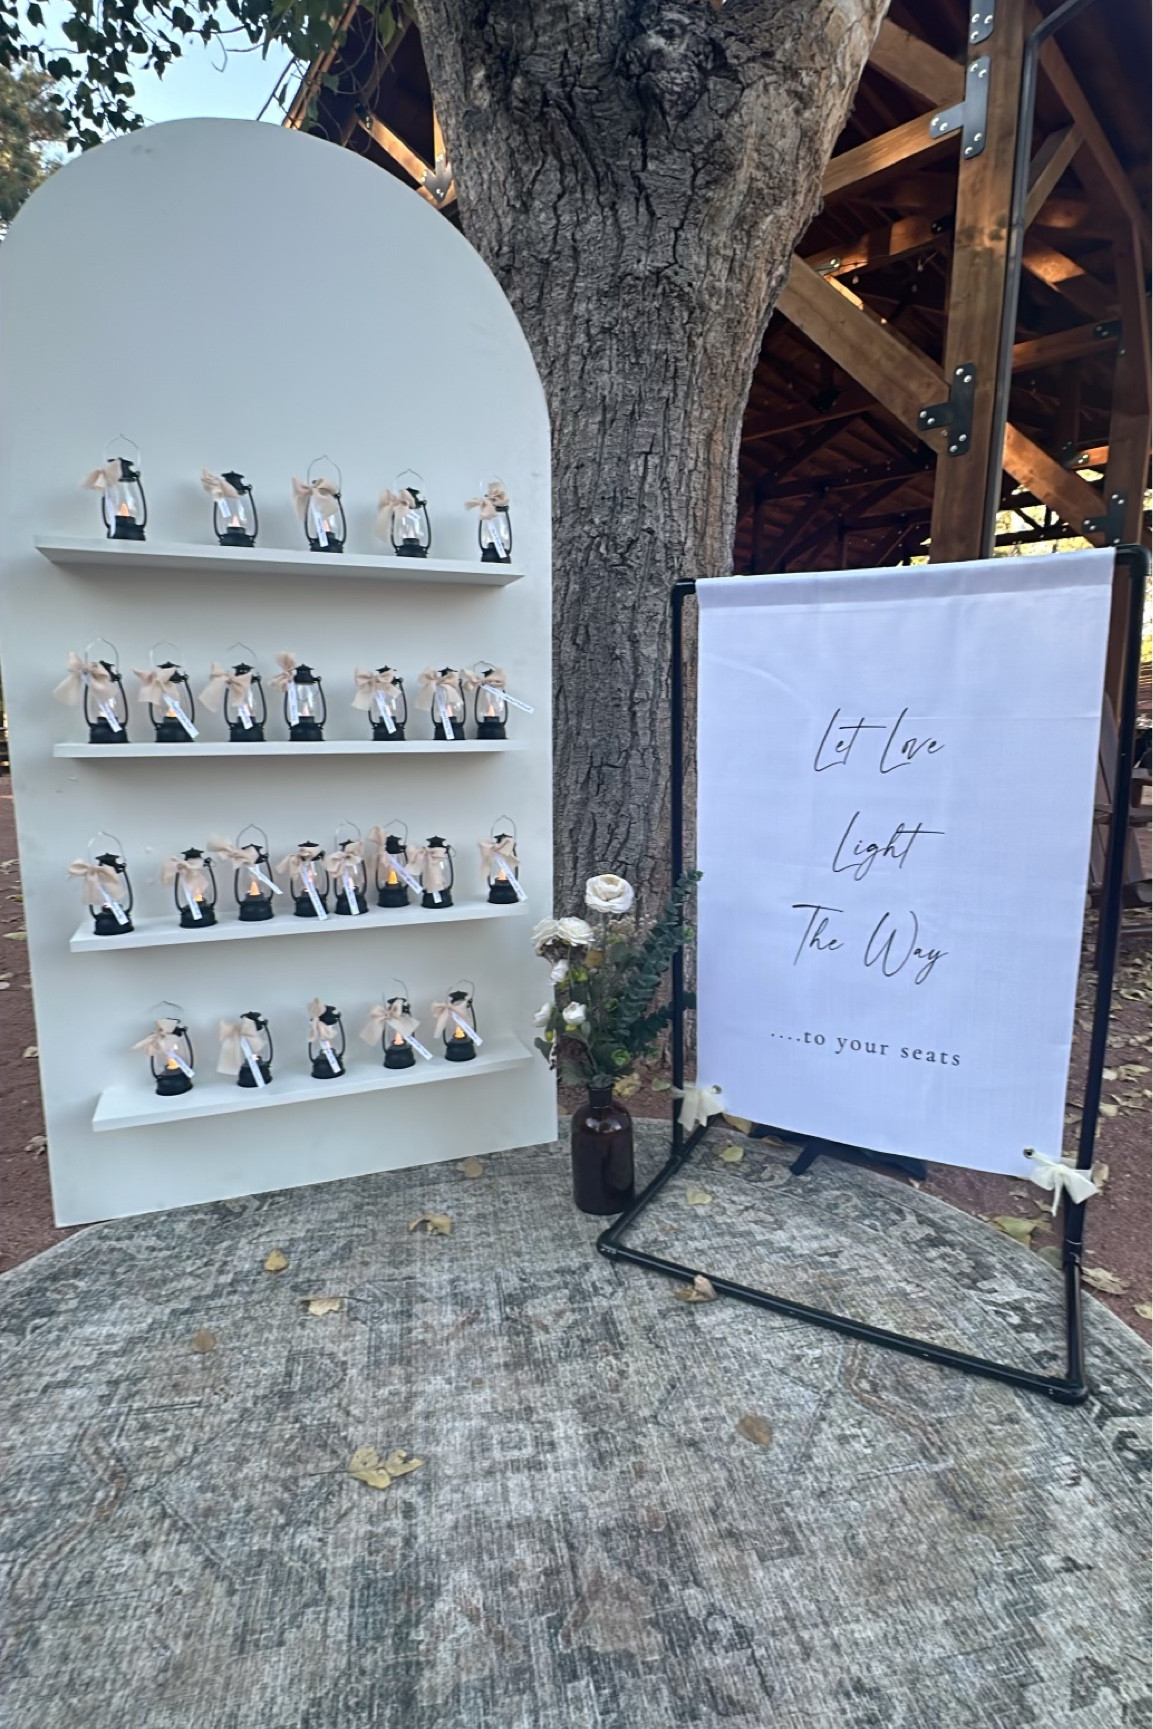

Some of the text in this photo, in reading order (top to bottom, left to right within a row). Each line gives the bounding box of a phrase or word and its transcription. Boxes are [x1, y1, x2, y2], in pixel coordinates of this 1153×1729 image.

[814, 707, 945, 774] Let Love
[832, 811, 946, 881] Light
[792, 904, 949, 985] The Way
[835, 1036, 889, 1055] your
[900, 1046, 961, 1067] seats
